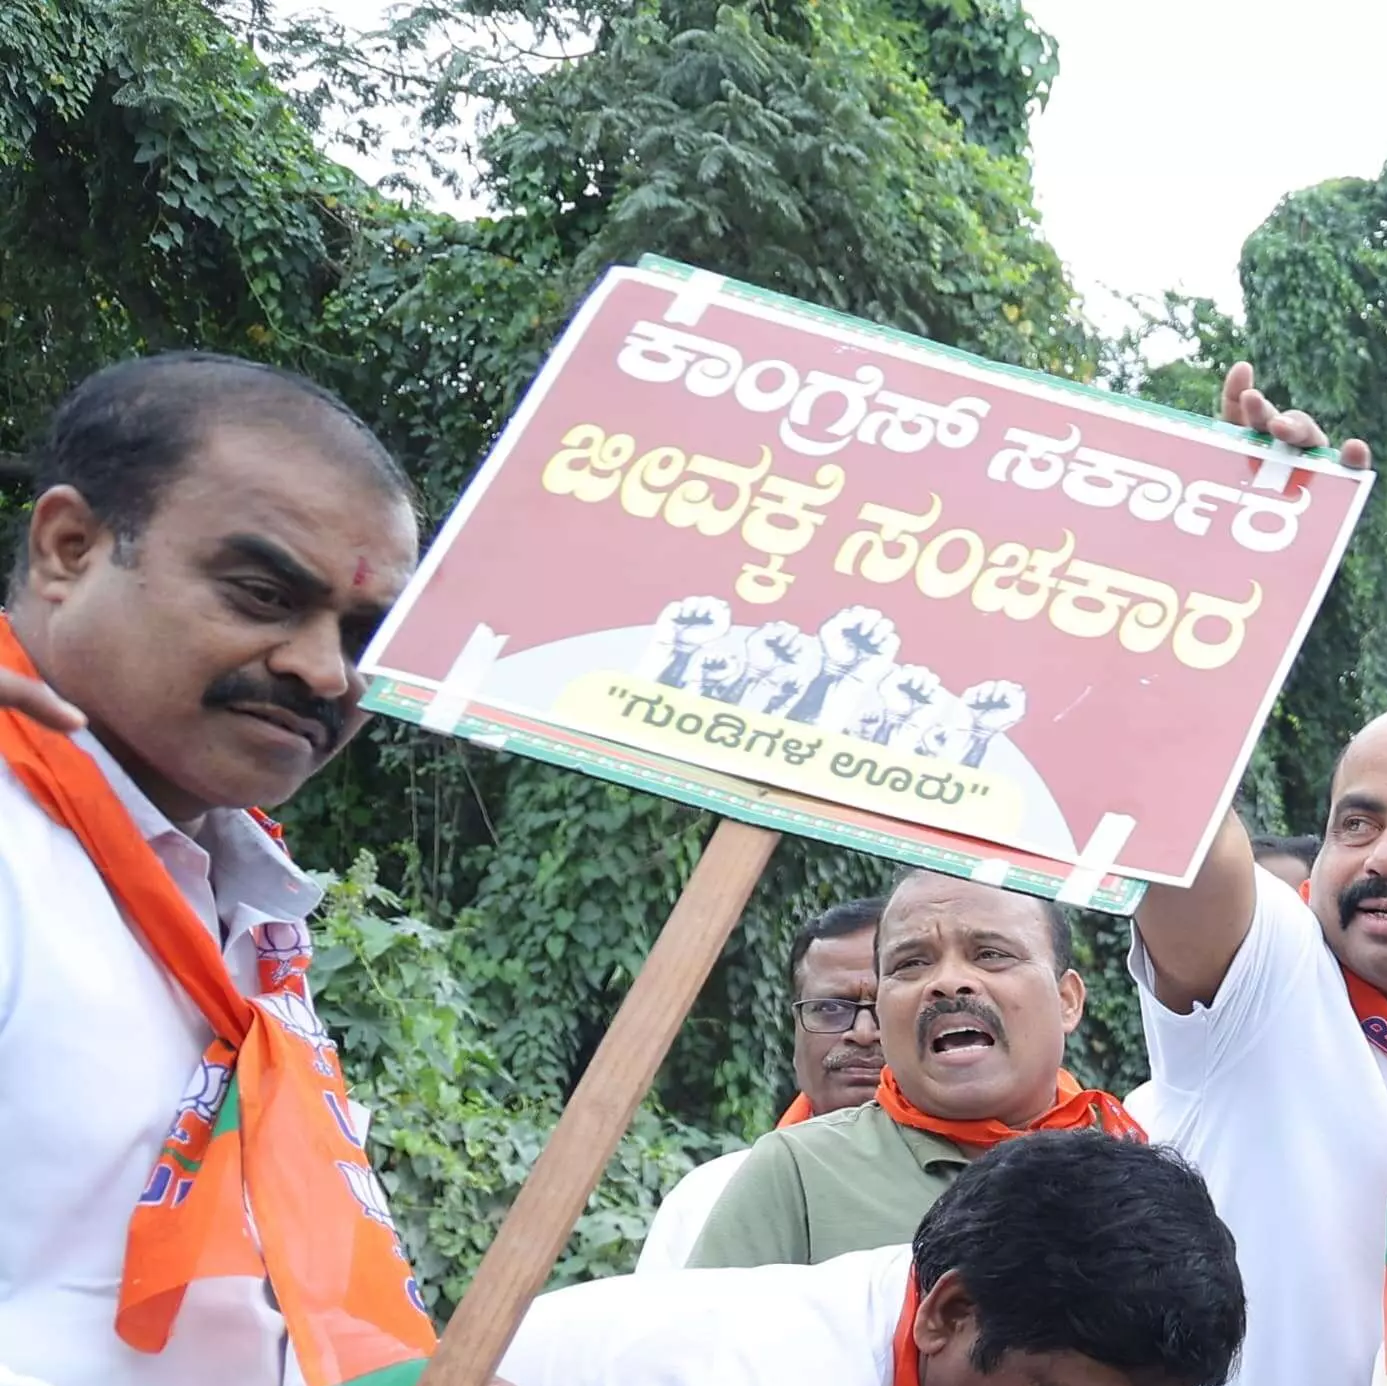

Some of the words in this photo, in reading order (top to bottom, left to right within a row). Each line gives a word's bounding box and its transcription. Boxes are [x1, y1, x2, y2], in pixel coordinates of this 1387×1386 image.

[543, 422, 845, 604] ಜೀವಕ್ಕೆ
[837, 492, 1263, 669] ಸಂಚಕಾರ
[617, 321, 990, 455] ಕಾಂಗ್ರೆಸ್
[988, 422, 1310, 553] ಸರ್ಕಾರ
[608, 685, 823, 766] "ಗುಂಡಿಗಳ
[830, 752, 990, 805] ಊರು"
